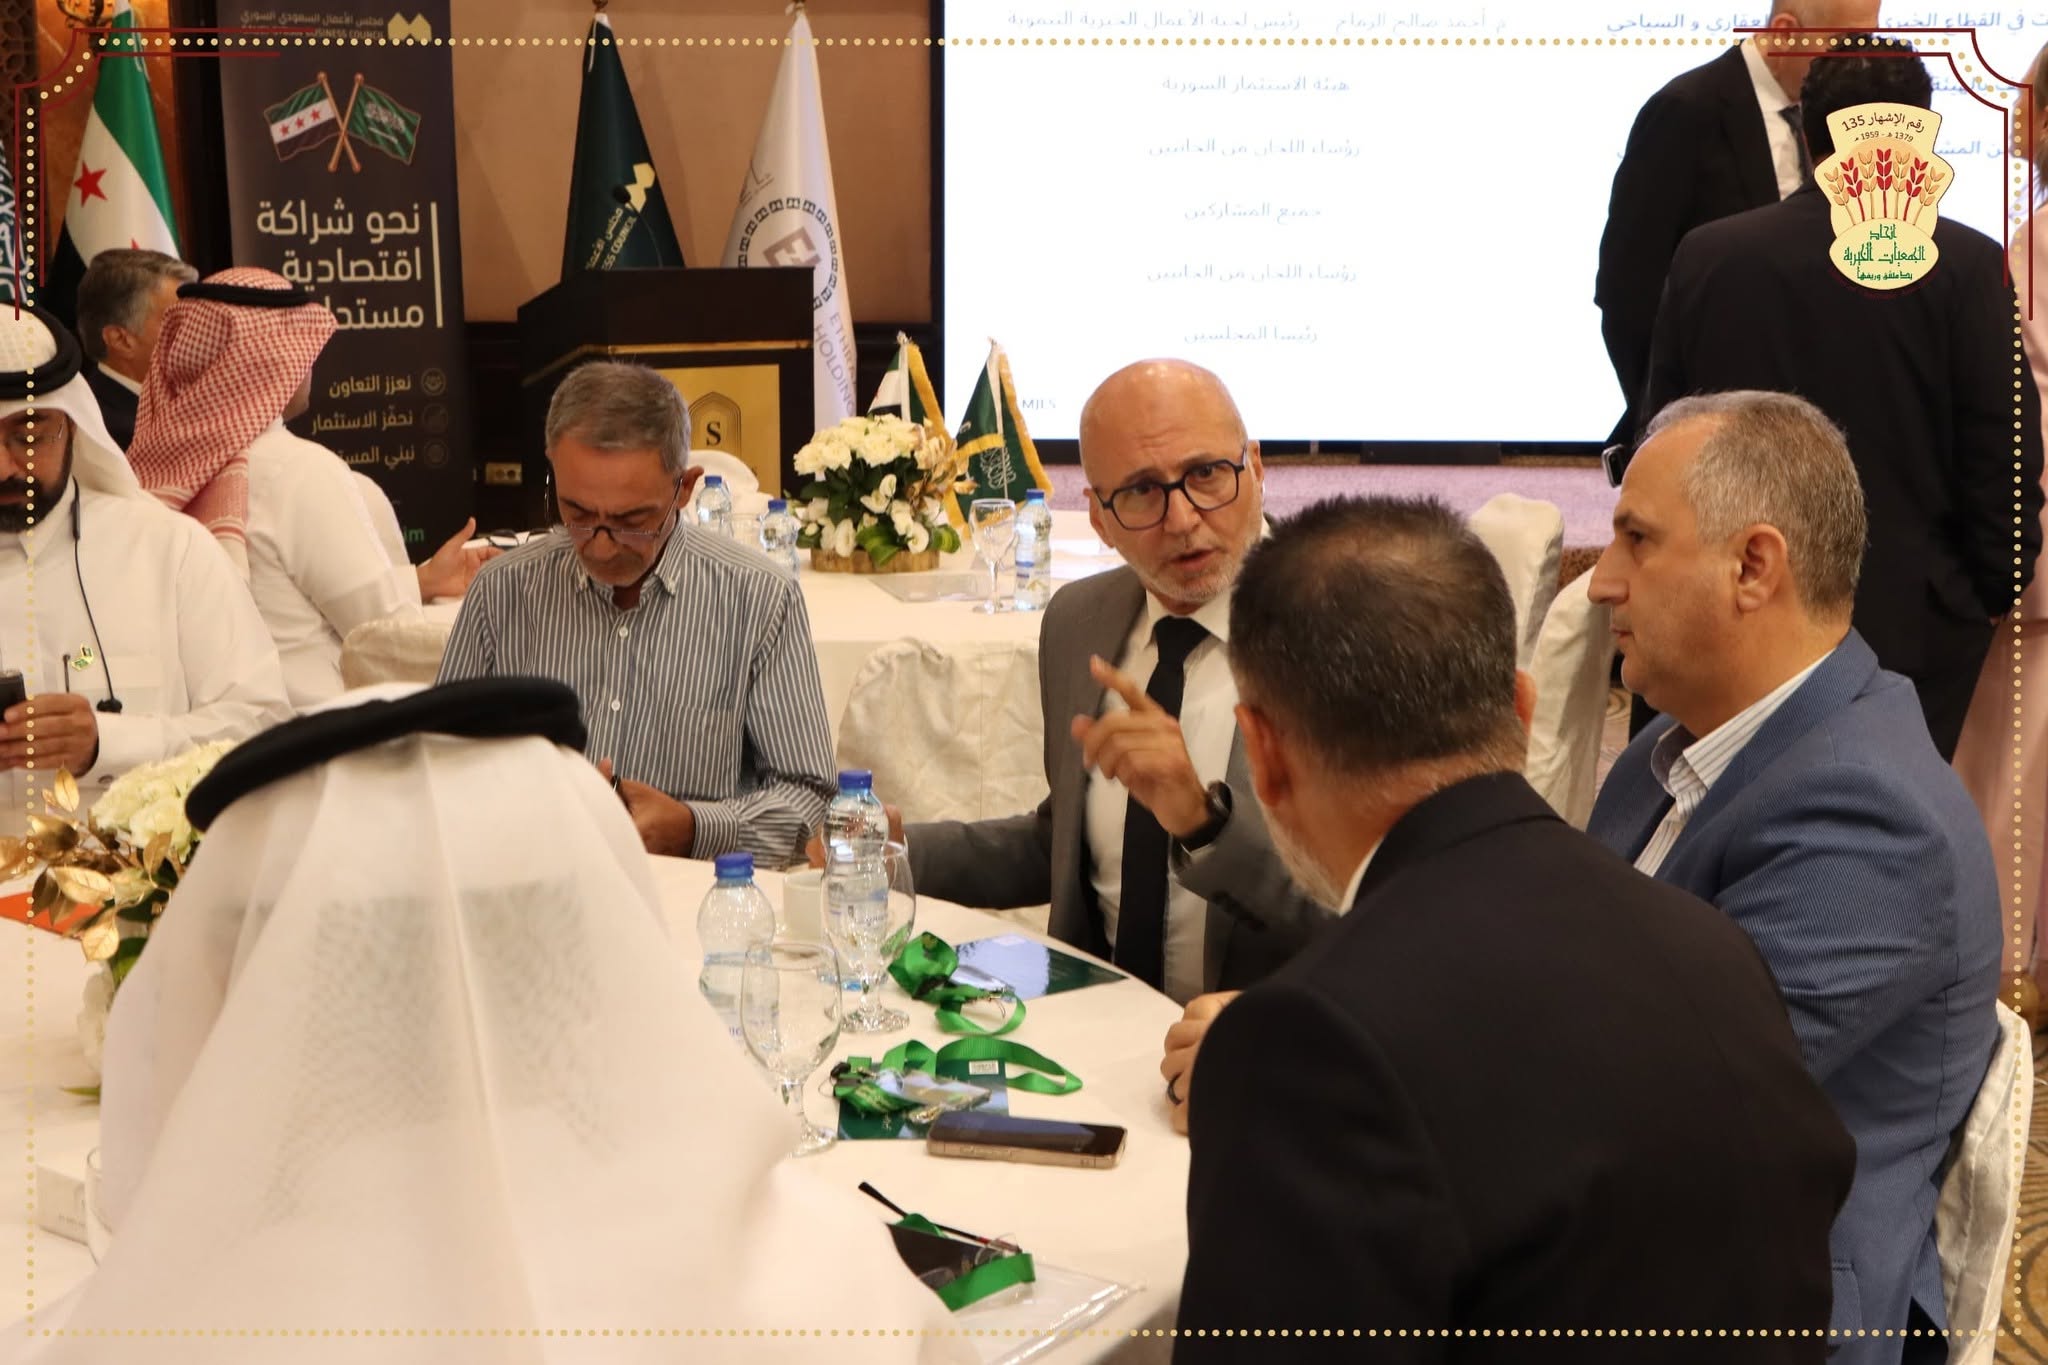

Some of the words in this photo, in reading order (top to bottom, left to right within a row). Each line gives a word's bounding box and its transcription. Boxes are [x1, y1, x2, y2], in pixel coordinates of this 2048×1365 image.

[355, 15, 384, 27] مجلس
[1606, 13, 1685, 36] السياحي
[256, 197, 354, 244] شراكة
[366, 202, 420, 244] نحو
[282, 246, 422, 292] اقتصادية
[814, 323, 856, 417] HOLDING
[328, 374, 380, 399] التعاون
[384, 374, 413, 396] نعزز
[311, 409, 378, 436] الاستثمار
[706, 420, 722, 447] S
[384, 444, 415, 471] نبني
